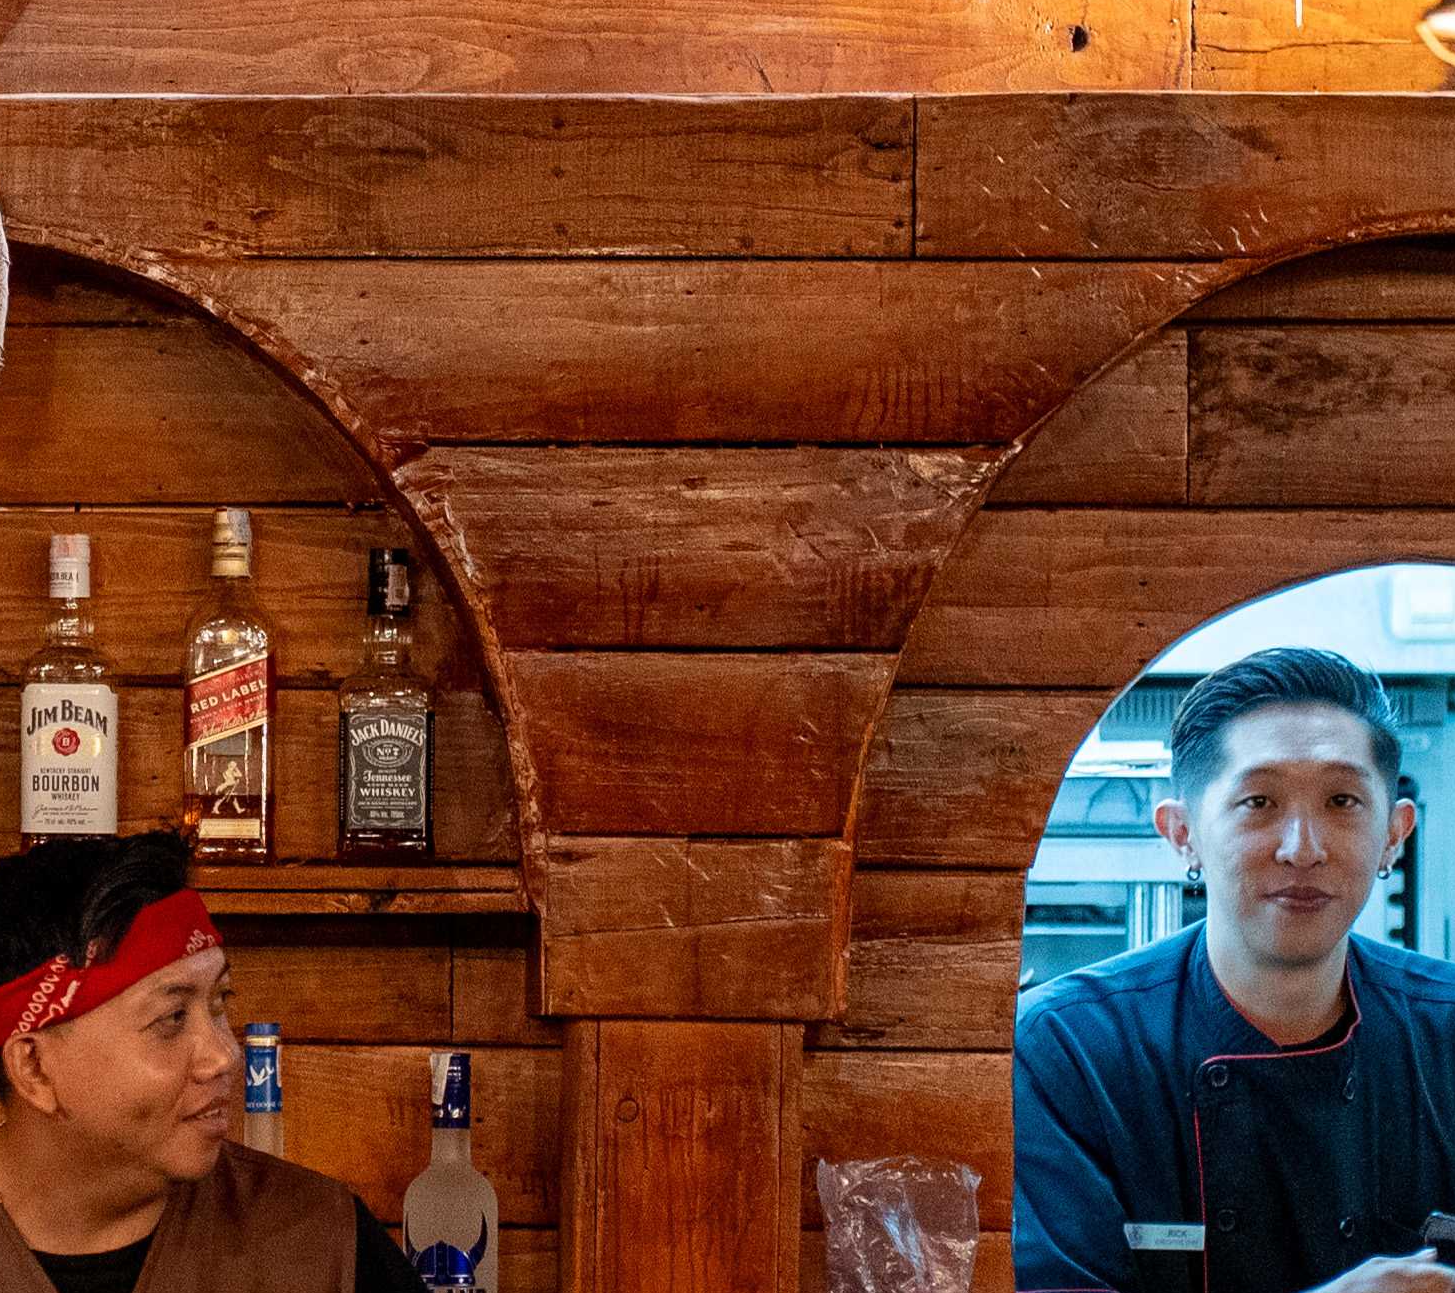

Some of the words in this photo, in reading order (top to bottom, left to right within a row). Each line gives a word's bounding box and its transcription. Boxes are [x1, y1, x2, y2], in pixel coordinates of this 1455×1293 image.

[190, 696, 219, 714] RED
[222, 679, 268, 702] LABEL
[27, 706, 59, 736] JIM
[60, 699, 108, 738] BEAM
[350, 724, 380, 747] JACK
[32, 774, 100, 792] BOURBON
[362, 769, 412, 782] Tennessee
[359, 787, 417, 797] WHISKEY
